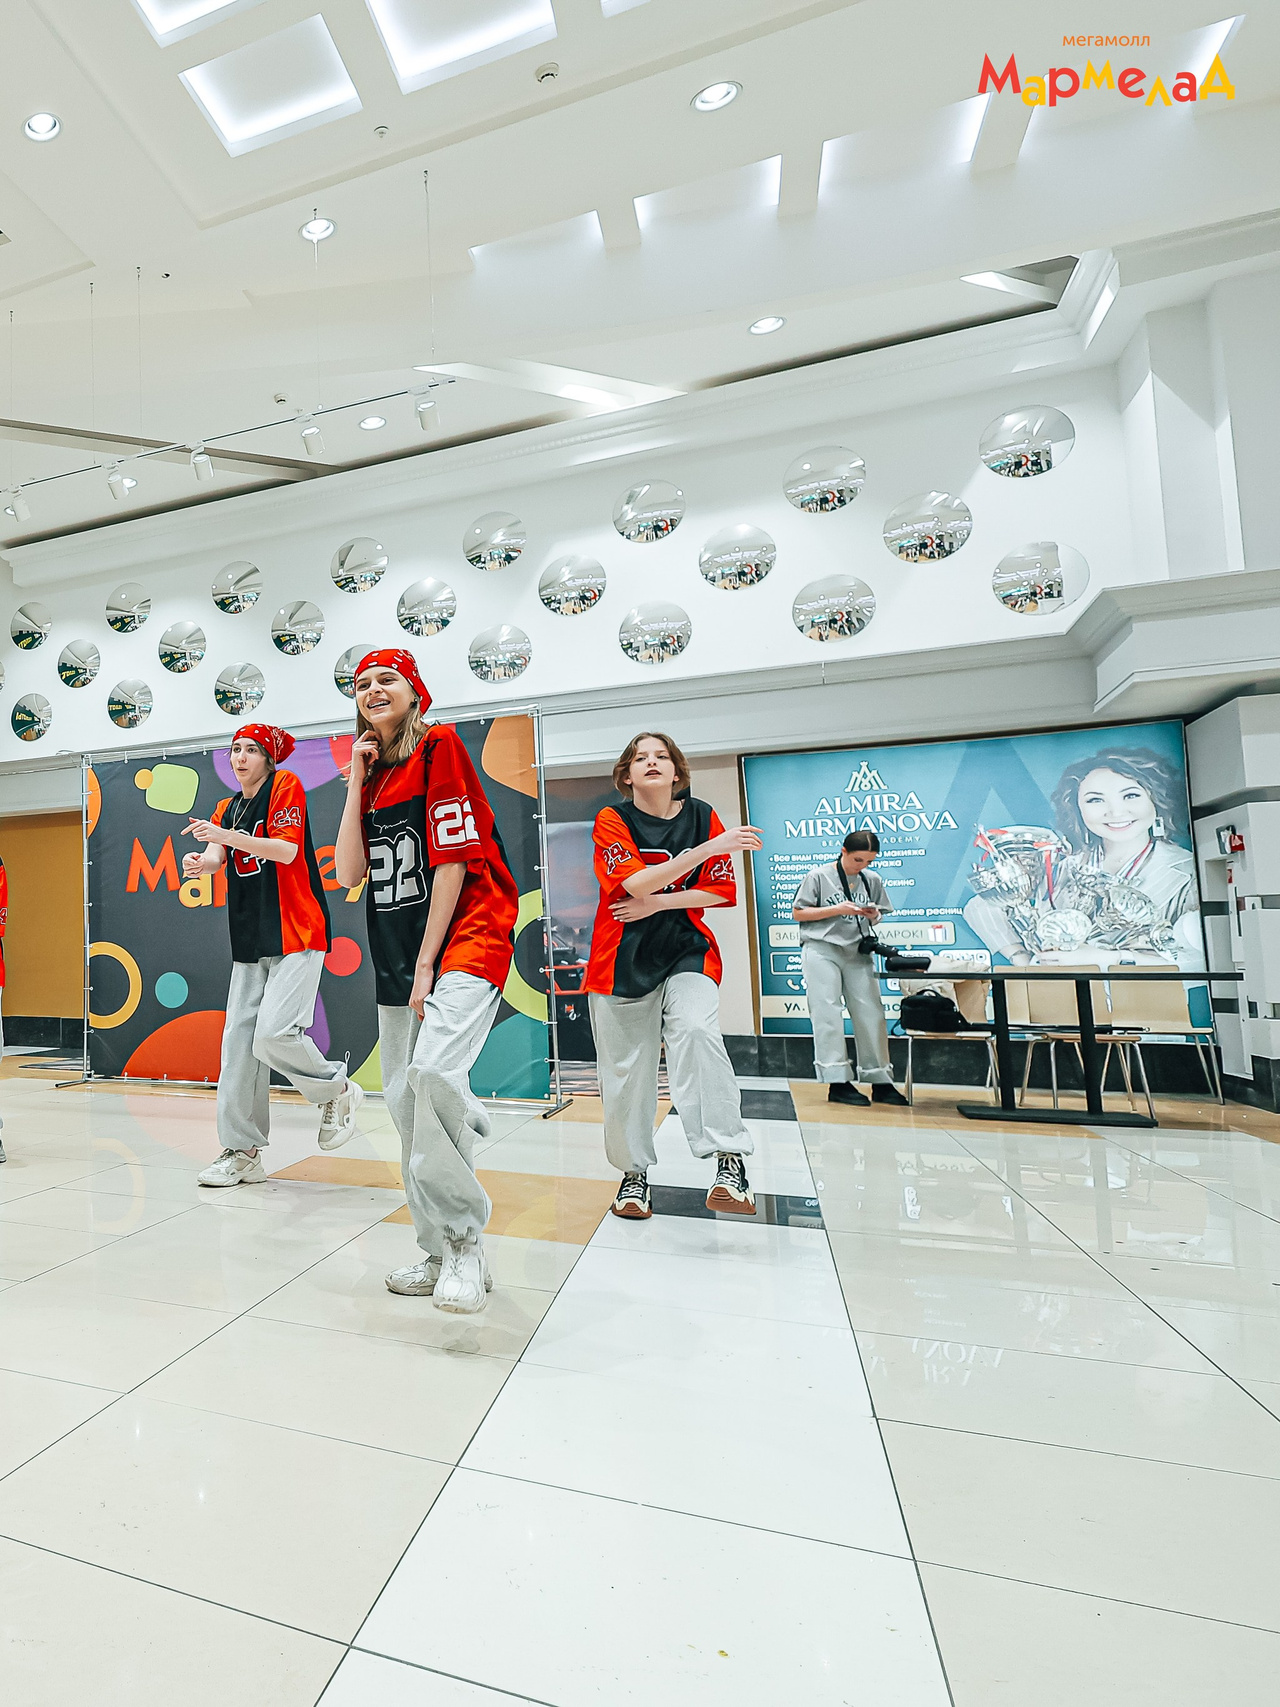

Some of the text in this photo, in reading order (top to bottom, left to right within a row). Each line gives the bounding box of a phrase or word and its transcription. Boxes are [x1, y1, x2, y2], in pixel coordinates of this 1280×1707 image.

[814, 791, 924, 816] ALMIRA
[273, 807, 302, 828] 24
[784, 810, 959, 839] MIRMANOVA
